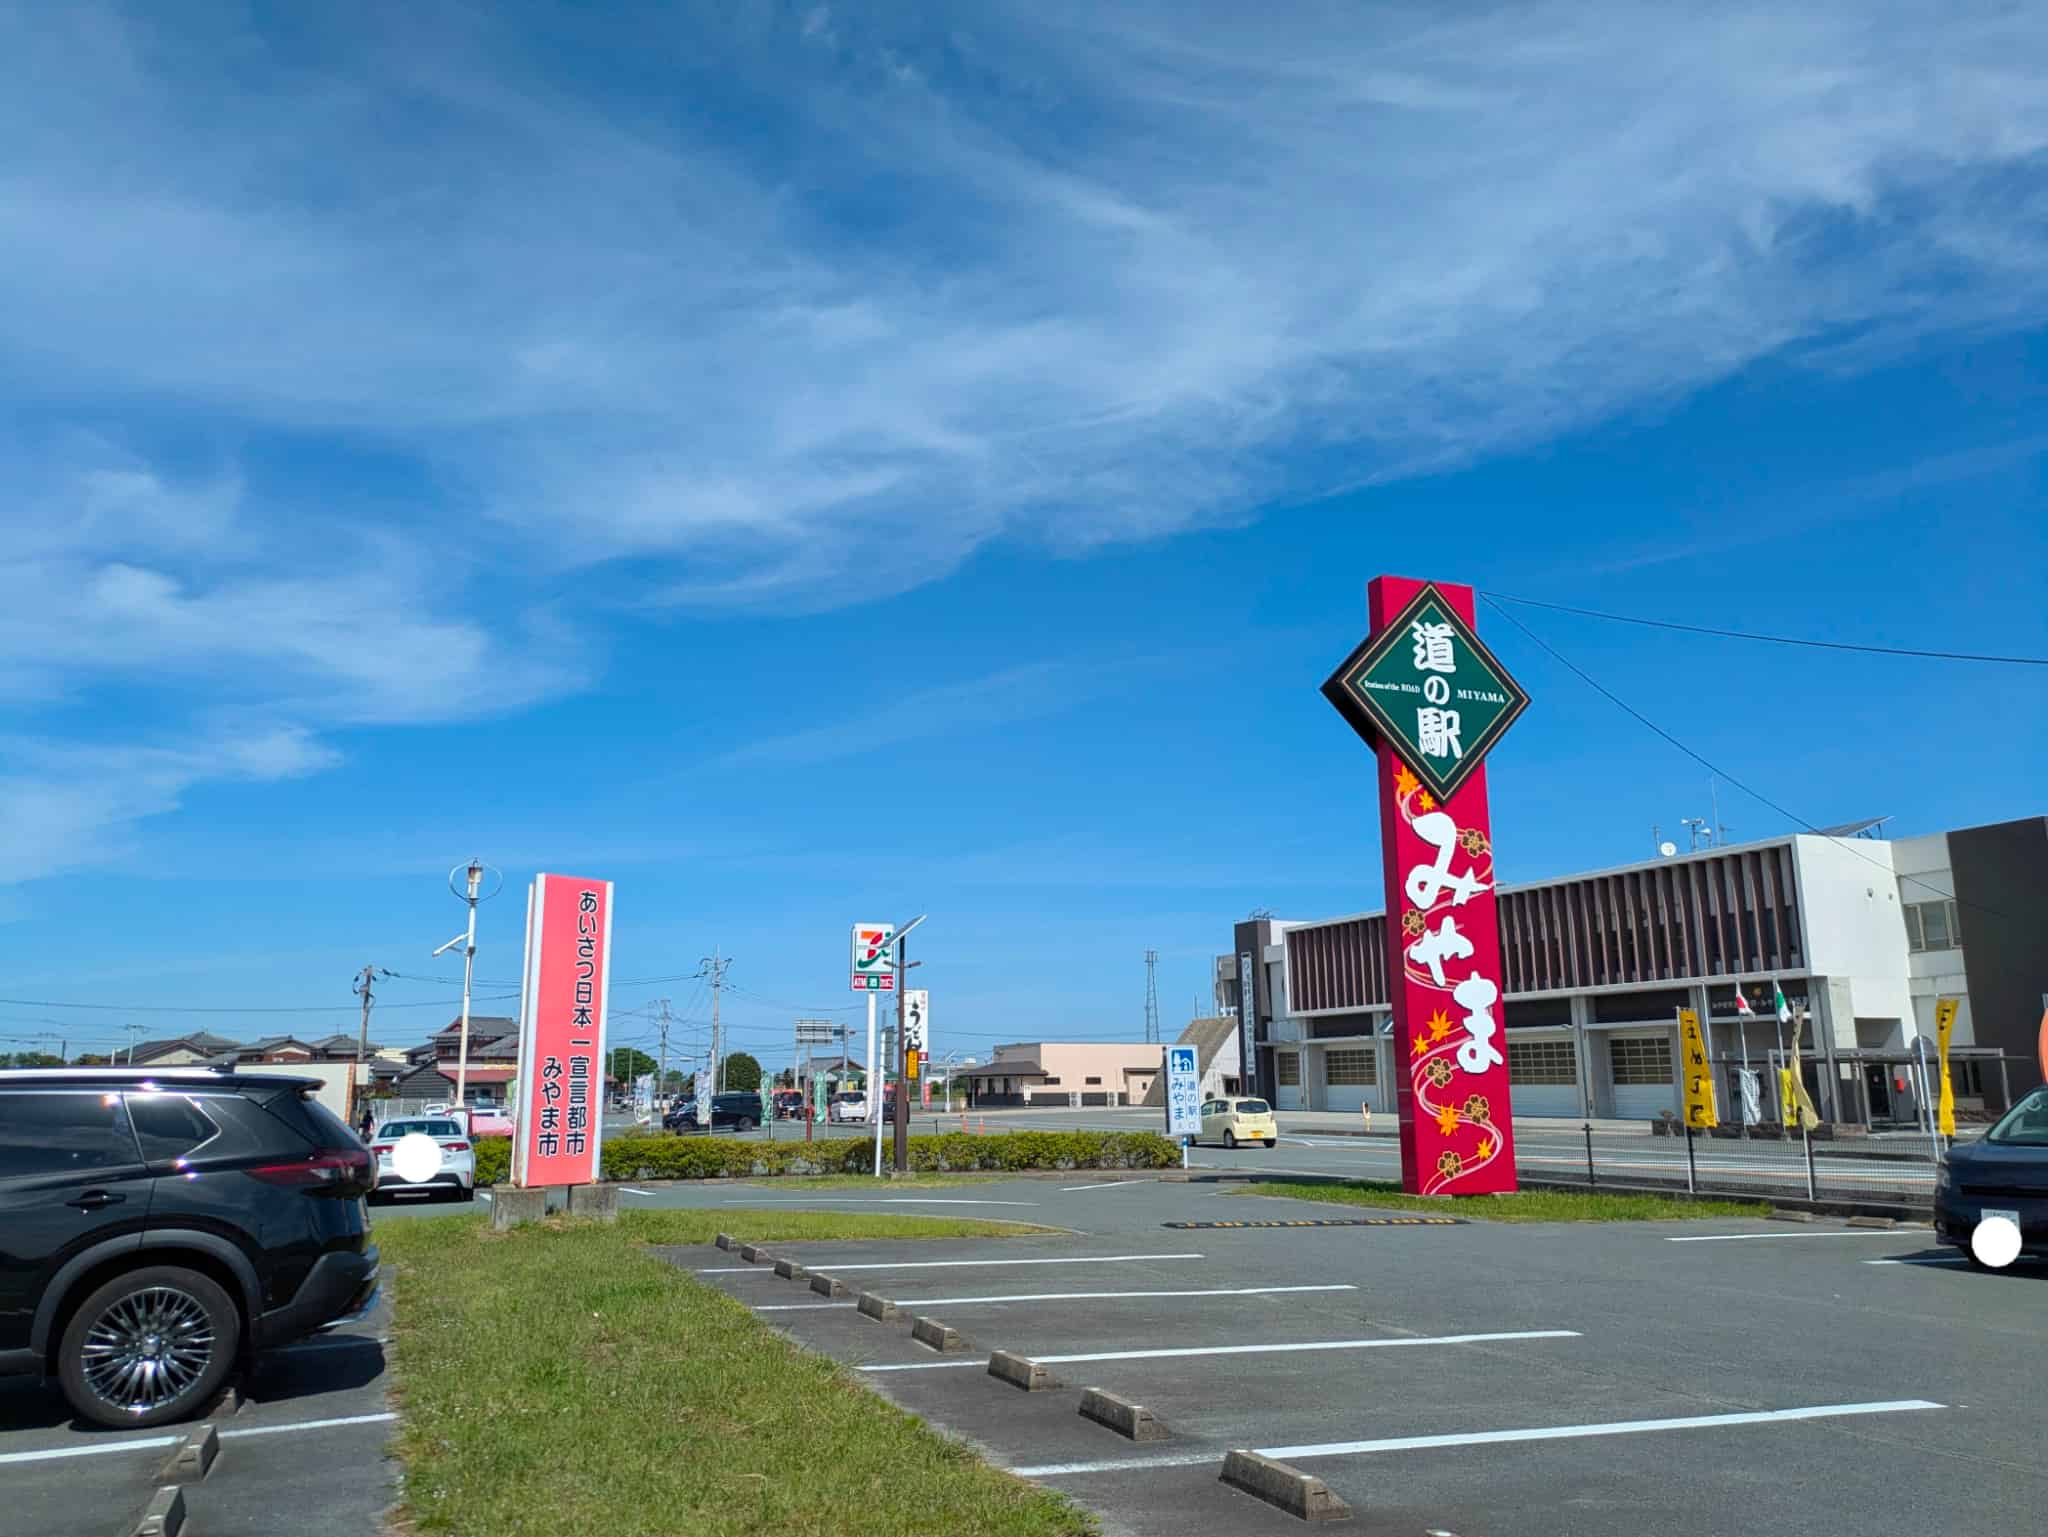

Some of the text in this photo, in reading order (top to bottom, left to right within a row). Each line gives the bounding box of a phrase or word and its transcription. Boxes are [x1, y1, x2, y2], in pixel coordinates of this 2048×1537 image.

[1412, 621, 1463, 759] 道の駅
[1457, 689, 1505, 703] MIYAMA
[1405, 812, 1504, 1073] みやま
[565, 891, 598, 1156] あいさつ日本一宣言都市
[538, 1057, 563, 1156] みやま市
